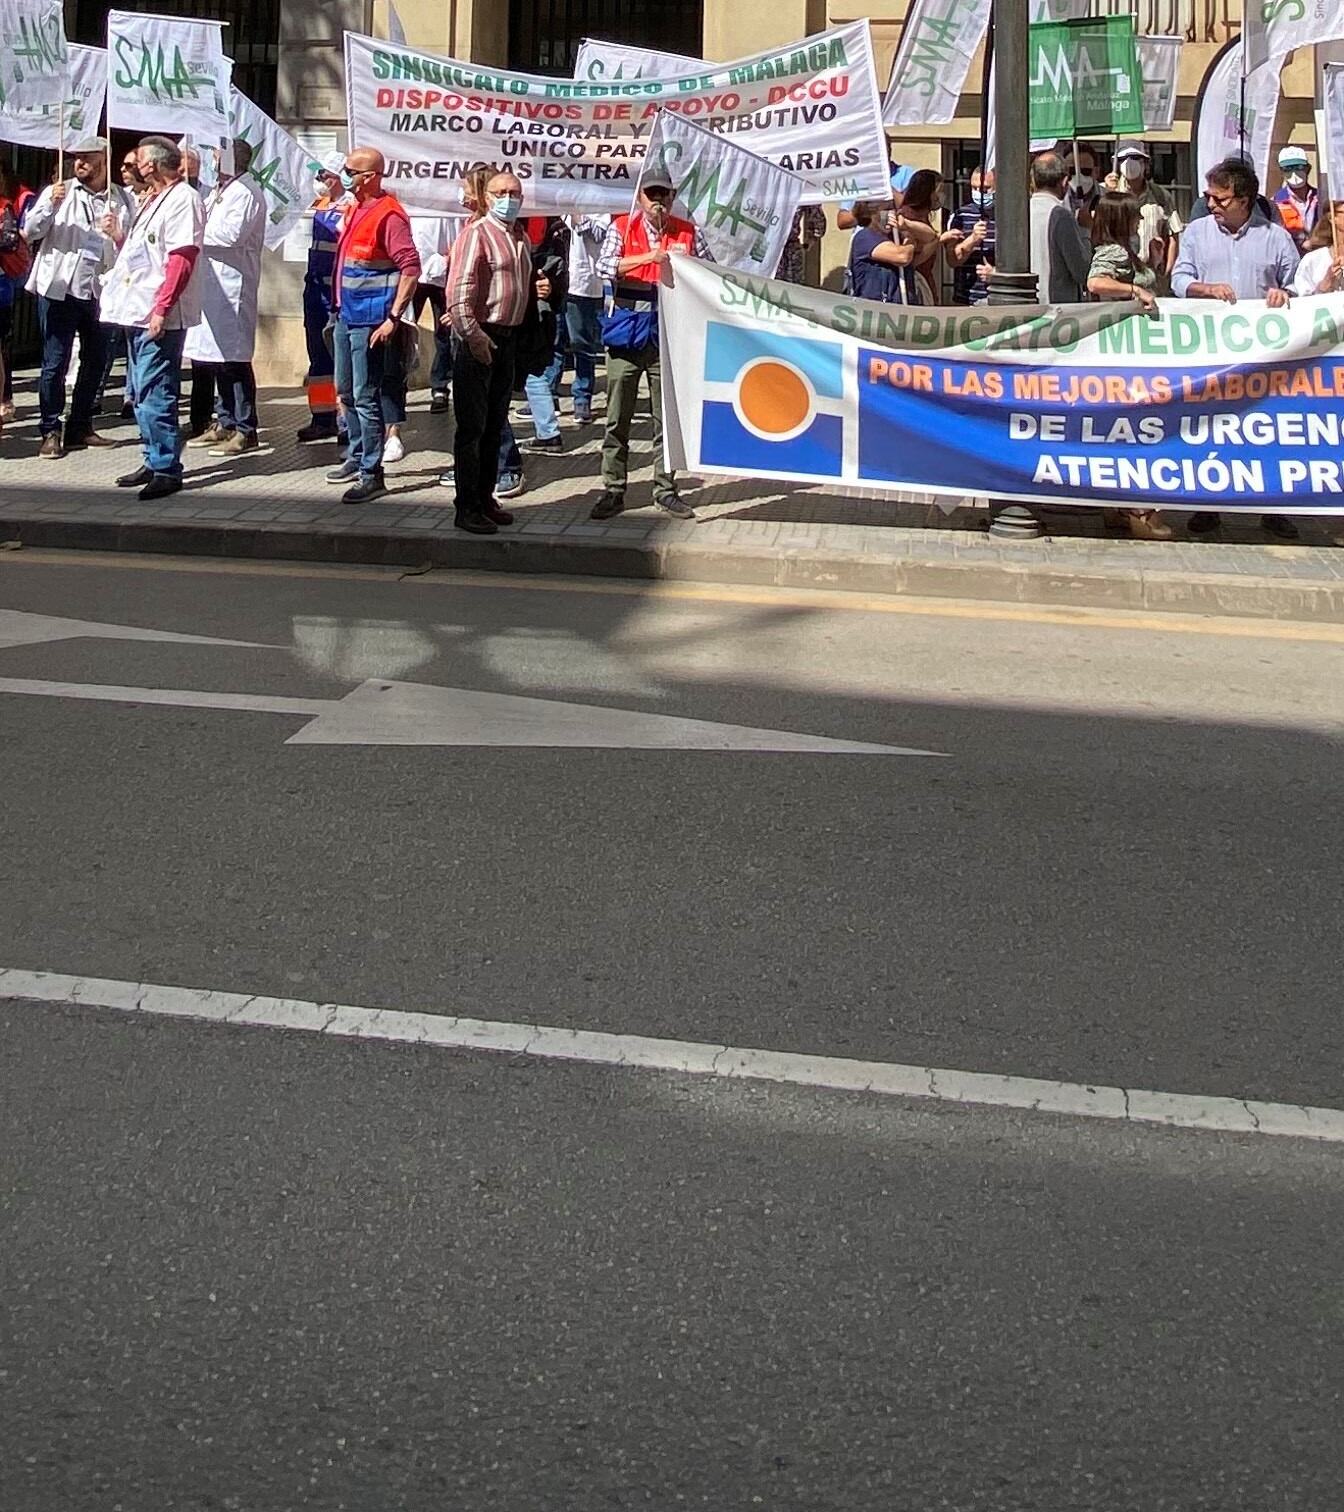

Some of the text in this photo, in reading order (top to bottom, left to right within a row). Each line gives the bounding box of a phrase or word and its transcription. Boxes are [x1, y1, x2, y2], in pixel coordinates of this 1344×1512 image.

[115, 32, 216, 102] SMA
[372, 38, 849, 97] SINDICATO MÉDICO DE MÁLAGA
[376, 88, 582, 120] DISPOSITIVOS
[592, 104, 632, 120] DE
[640, 92, 740, 120] APOYO
[767, 75, 849, 104] DCCU
[390, 113, 483, 134] MARCO
[492, 118, 619, 140] LABORAL
[630, 123, 647, 140] Y
[501, 136, 646, 159] ÚNICO PAR
[823, 178, 870, 196] SMA
[743, 197, 779, 227] Sevilla
[720, 273, 808, 320] SMA
[831, 304, 1082, 354] SINDICATO
[870, 358, 933, 392] POR
[943, 368, 1004, 399] LAS
[1014, 373, 1173, 407] MEJORAS
[1008, 413, 1065, 442] DE
[1080, 415, 1165, 444] LAS
[1031, 451, 1265, 493] ATENCIÓN
